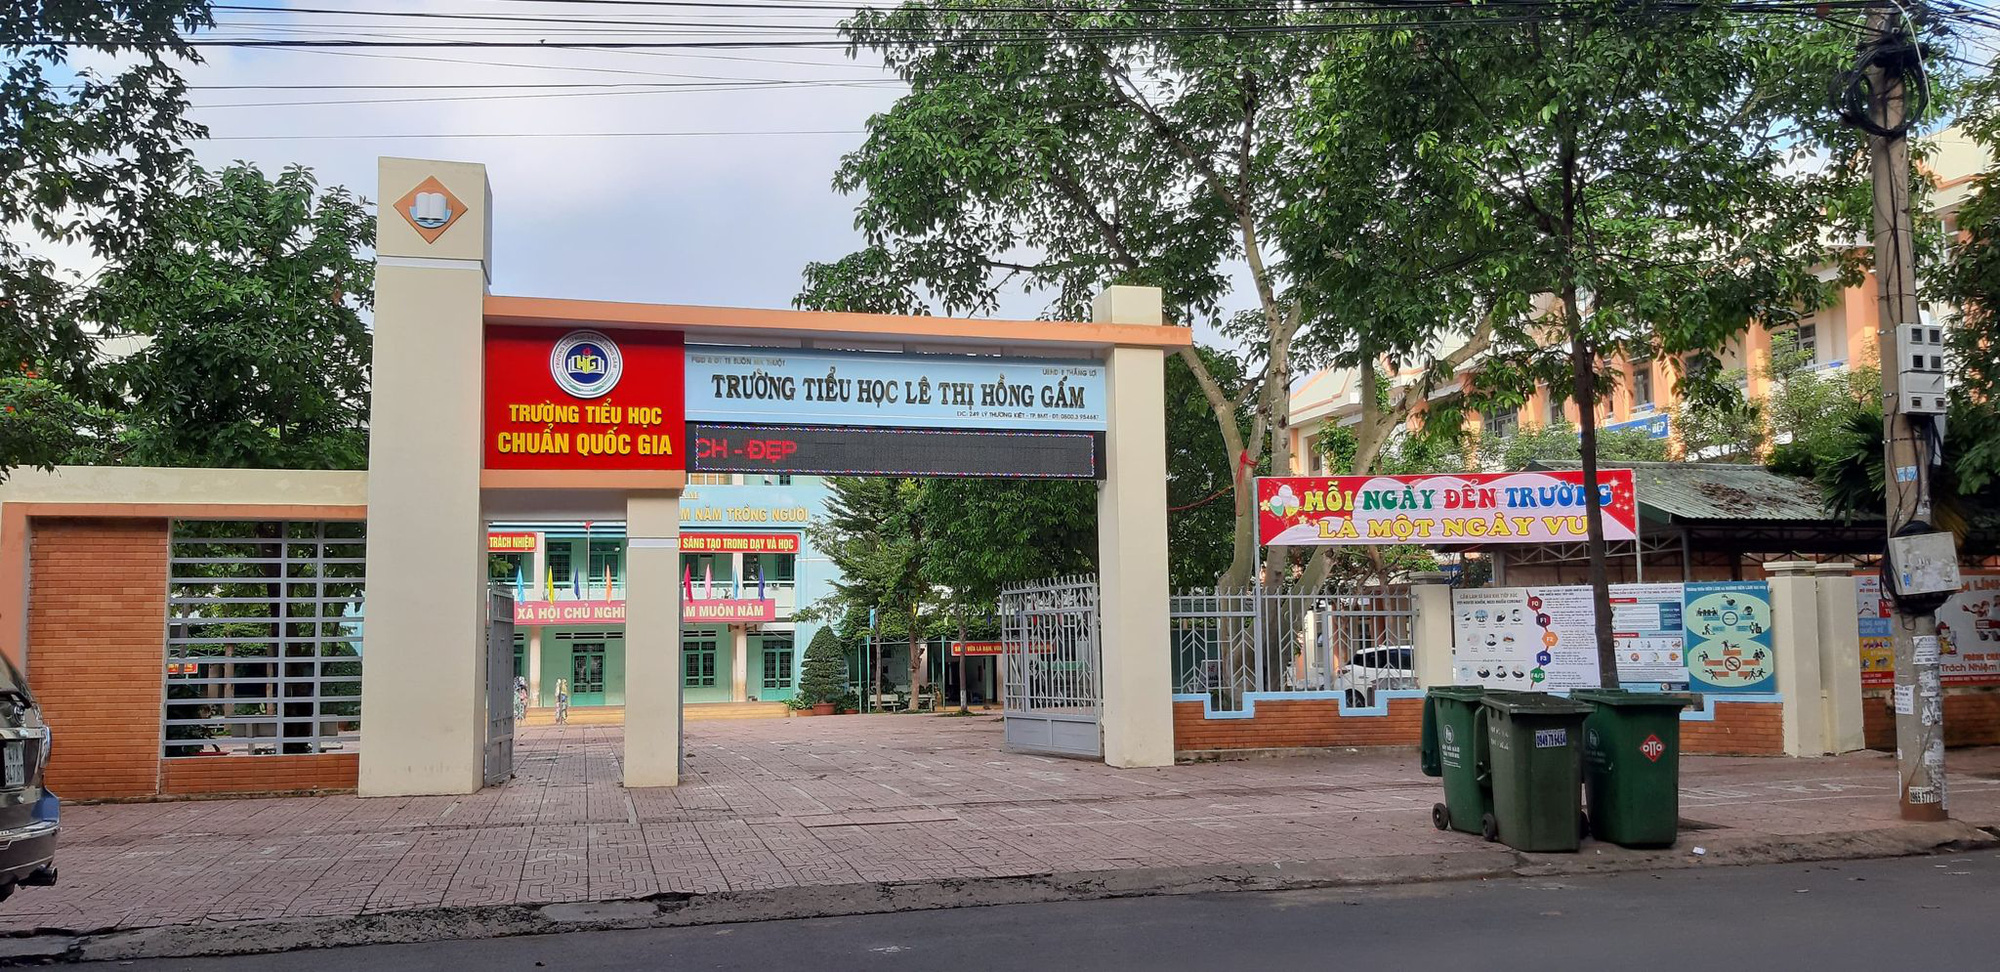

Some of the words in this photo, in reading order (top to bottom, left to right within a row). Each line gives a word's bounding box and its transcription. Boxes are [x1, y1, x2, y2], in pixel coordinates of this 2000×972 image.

[711, 369, 796, 401] TRƯỜNG
[802, 366, 852, 402] TIỂU
[857, 379, 899, 408] HỌC
[905, 376, 932, 404] LÊ
[938, 382, 974, 410] THỊ
[980, 373, 1034, 407] HỒNG
[1041, 376, 1085, 409] GẤM
[508, 400, 579, 424] TRƯỜNG
[585, 398, 622, 424] TIỂU
[628, 407, 662, 428] HỌC
[498, 423, 569, 454] CHUẨN
[577, 426, 631, 456] QUỐC
[638, 434, 672, 455] GIA
[747, 439, 797, 464] ĐẸP
[1303, 480, 1354, 512] MỖI
[1362, 484, 1436, 511] NGÀY
[1444, 479, 1497, 509] ĐẾN
[695, 504, 722, 522] NĂM
[727, 503, 767, 522] TRỒNG
[771, 504, 809, 522] NGƯỜI
[1318, 515, 1359, 538] LÀ
[1367, 514, 1435, 541] MỘT
[1442, 512, 1535, 537] NGÀY
[1541, 515, 1588, 536] VU
[489, 535, 511, 548] TRÁCH
[513, 535, 534, 550] NHIỆM
[683, 536, 704, 549] SÁNG
[706, 538, 721, 551] TẠO
[723, 538, 748, 549] TRONG
[750, 538, 765, 551] DẠY
[767, 537, 777, 549] VÀ
[778, 538, 793, 551] HỌC
[517, 605, 534, 619] XÃ
[538, 605, 560, 622] HỘI
[564, 603, 591, 619] CHỦ
[594, 604, 625, 619] NGHĨ
[700, 603, 734, 617] MUÔN
[737, 603, 764, 617] NĂM
[1941, 663, 1966, 672] Trách
[1969, 663, 1997, 673] Nhiệm
